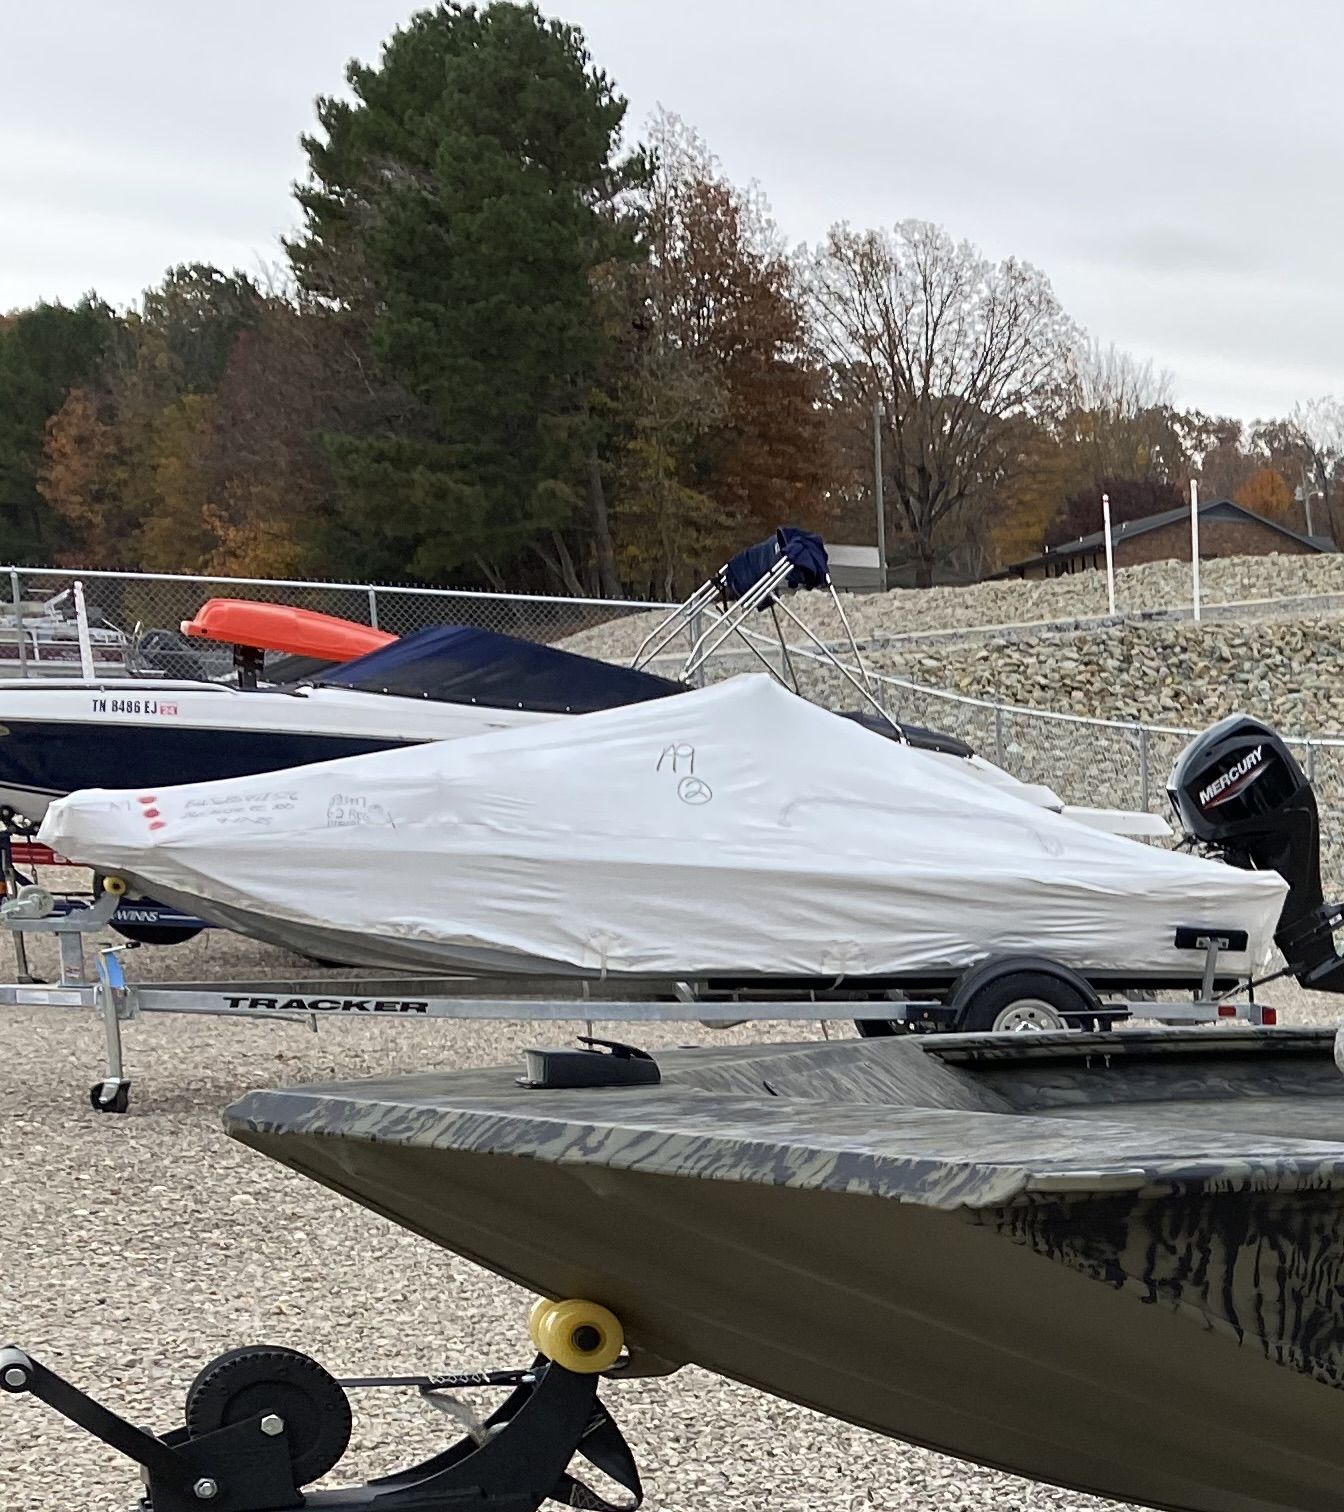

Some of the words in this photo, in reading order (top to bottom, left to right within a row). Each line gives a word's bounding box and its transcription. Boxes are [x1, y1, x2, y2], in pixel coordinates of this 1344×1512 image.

[92, 699, 106, 712] TN
[111, 699, 141, 713] 8486
[144, 700, 157, 714] EJ
[1199, 744, 1263, 806] MERCURY
[115, 909, 159, 922] WINNS
[222, 996, 429, 1013] TRACKER
